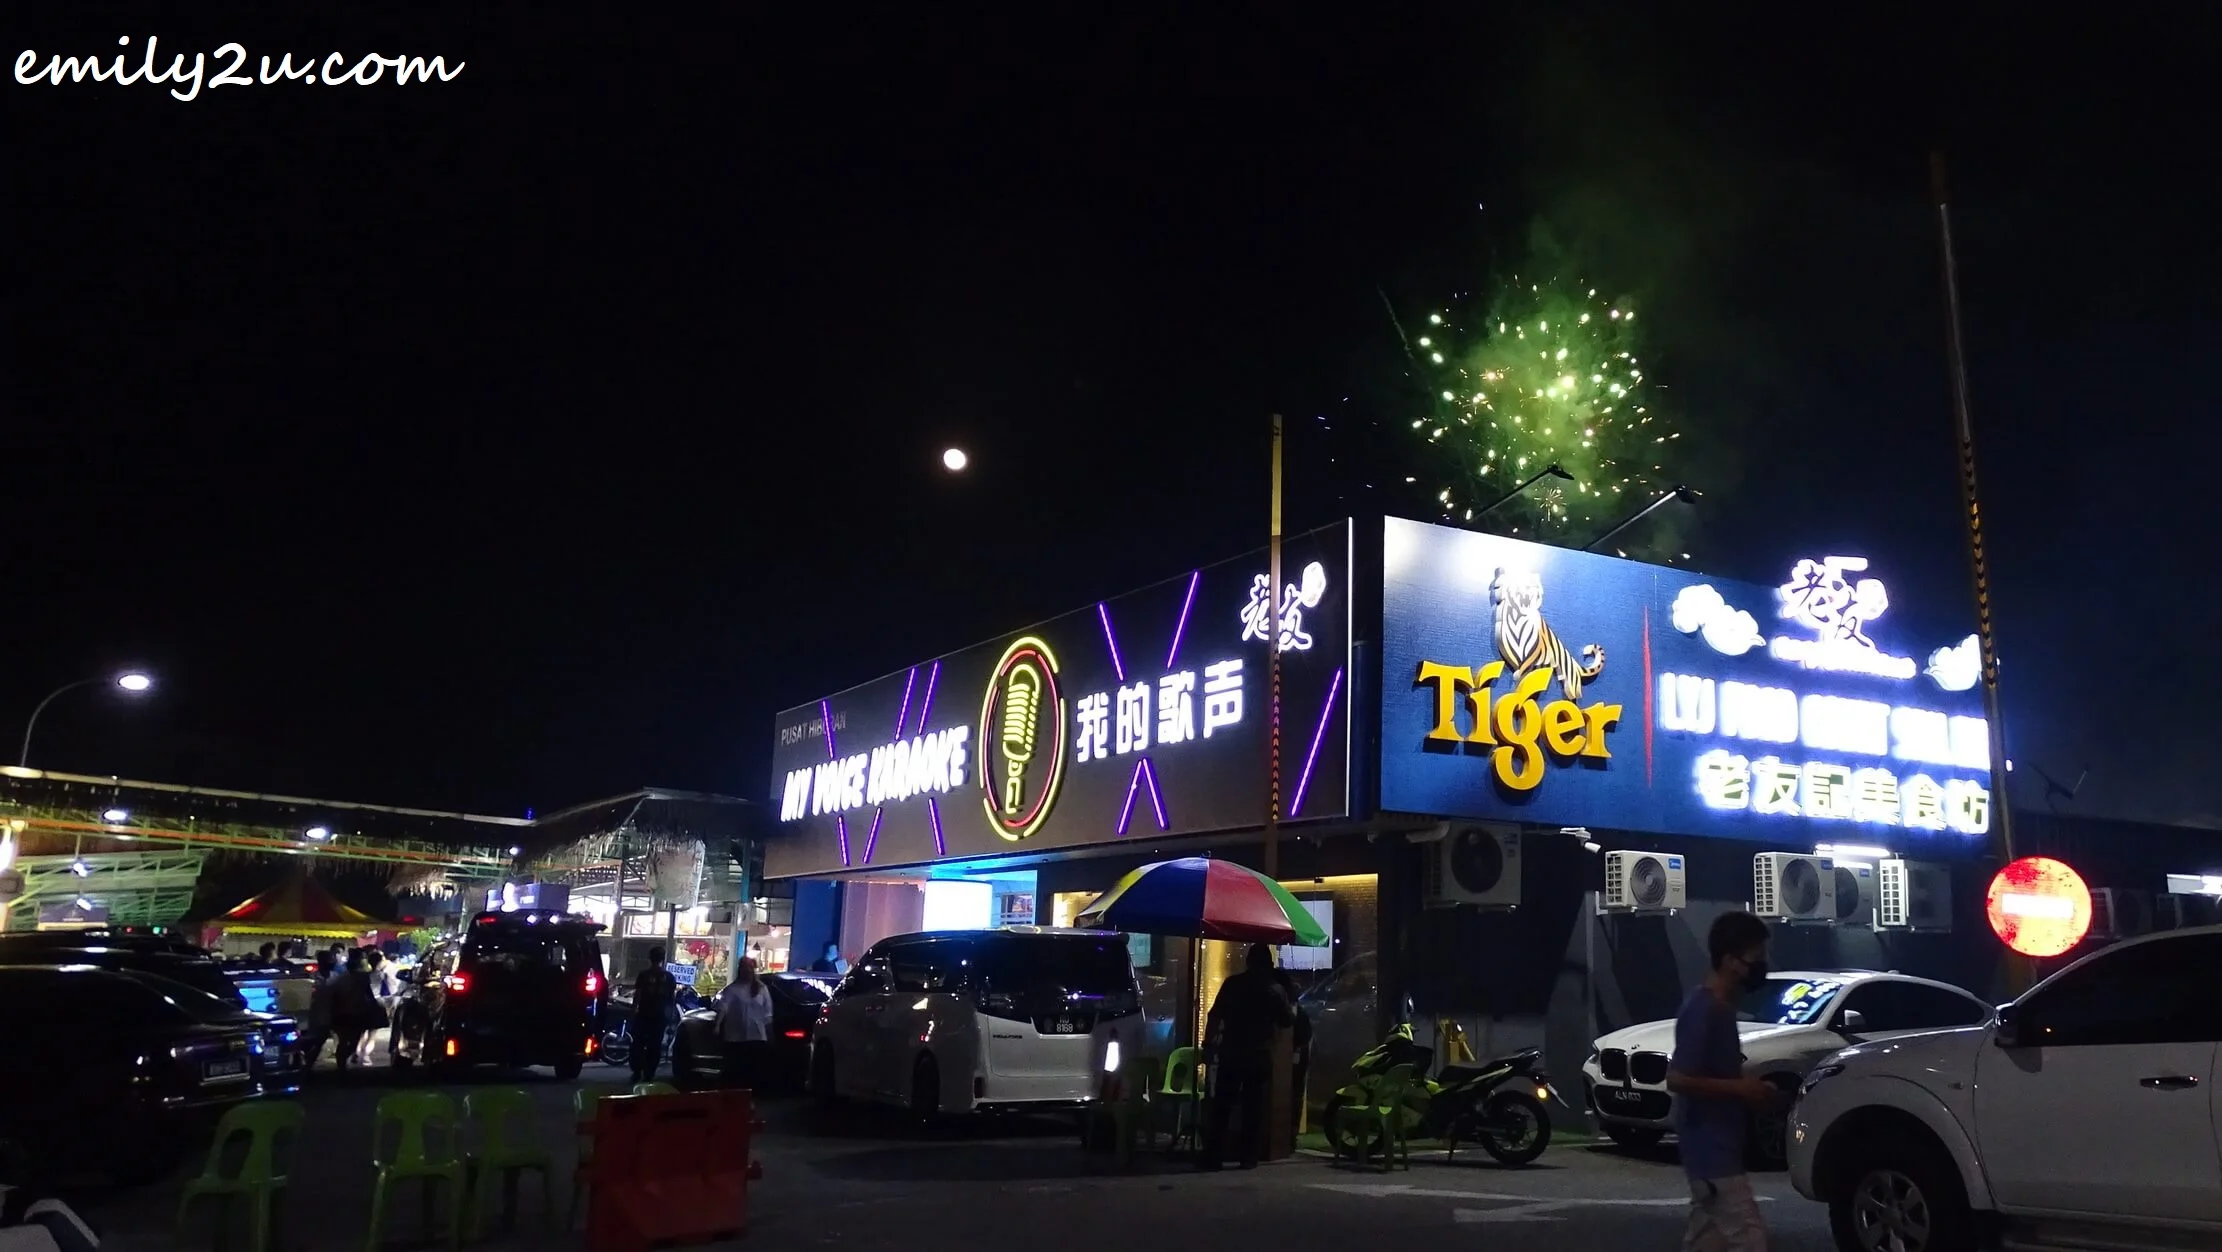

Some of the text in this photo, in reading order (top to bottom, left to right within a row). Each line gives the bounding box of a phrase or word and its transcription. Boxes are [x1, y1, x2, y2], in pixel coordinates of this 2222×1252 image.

[781, 722, 808, 747] PUSAT
[1077, 658, 1244, 763] 我的歌声
[1417, 660, 1624, 791] Tiger
[780, 724, 969, 822] MY VOICE KARAOKE
[667, 964, 695, 975] RESERVED
